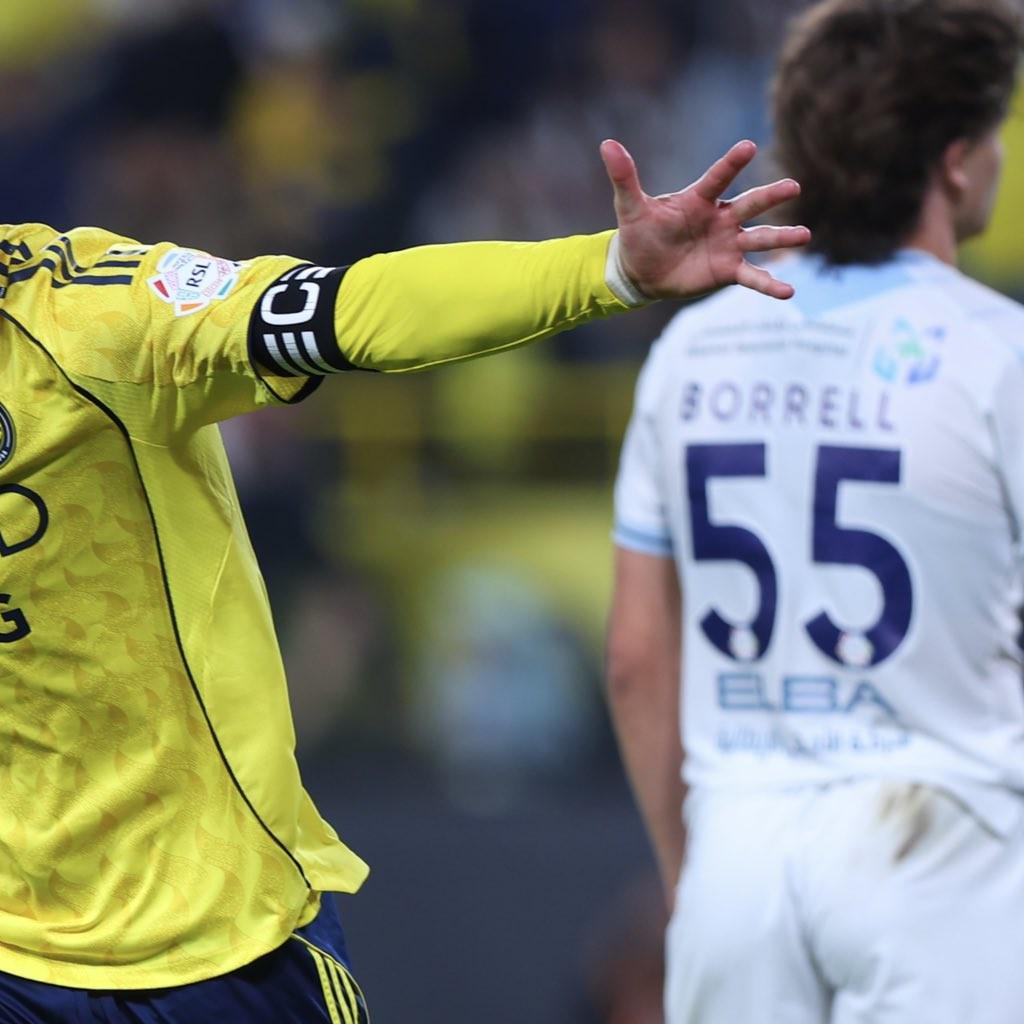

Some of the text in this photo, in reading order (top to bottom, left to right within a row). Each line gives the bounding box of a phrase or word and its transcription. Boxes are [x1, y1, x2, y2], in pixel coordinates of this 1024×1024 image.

[185, 261, 212, 288] RSL
[680, 380, 897, 432] BORRELL
[685, 441, 915, 670] 55
